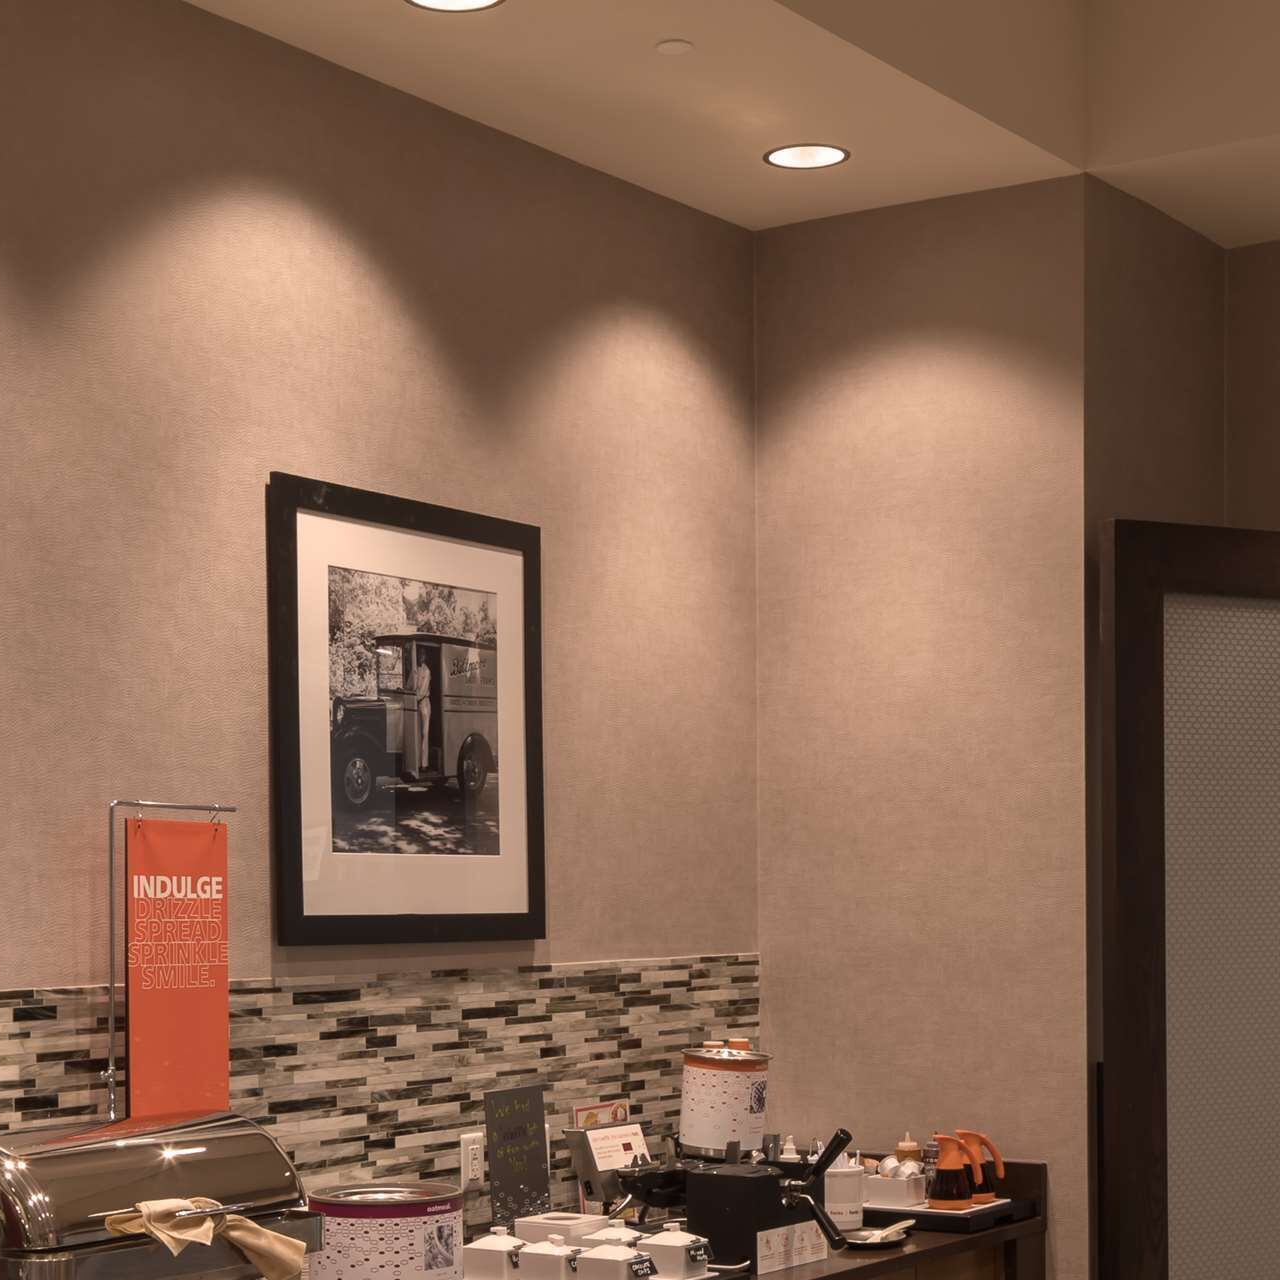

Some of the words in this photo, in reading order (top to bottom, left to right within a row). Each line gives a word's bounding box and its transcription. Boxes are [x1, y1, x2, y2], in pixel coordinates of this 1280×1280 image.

[133, 875, 223, 899] INDULGE
[134, 897, 222, 921] DRIZZLE
[134, 919, 223, 943] SPREAD
[128, 941, 229, 967] SPRINKLE
[141, 965, 216, 990] SMILE.
